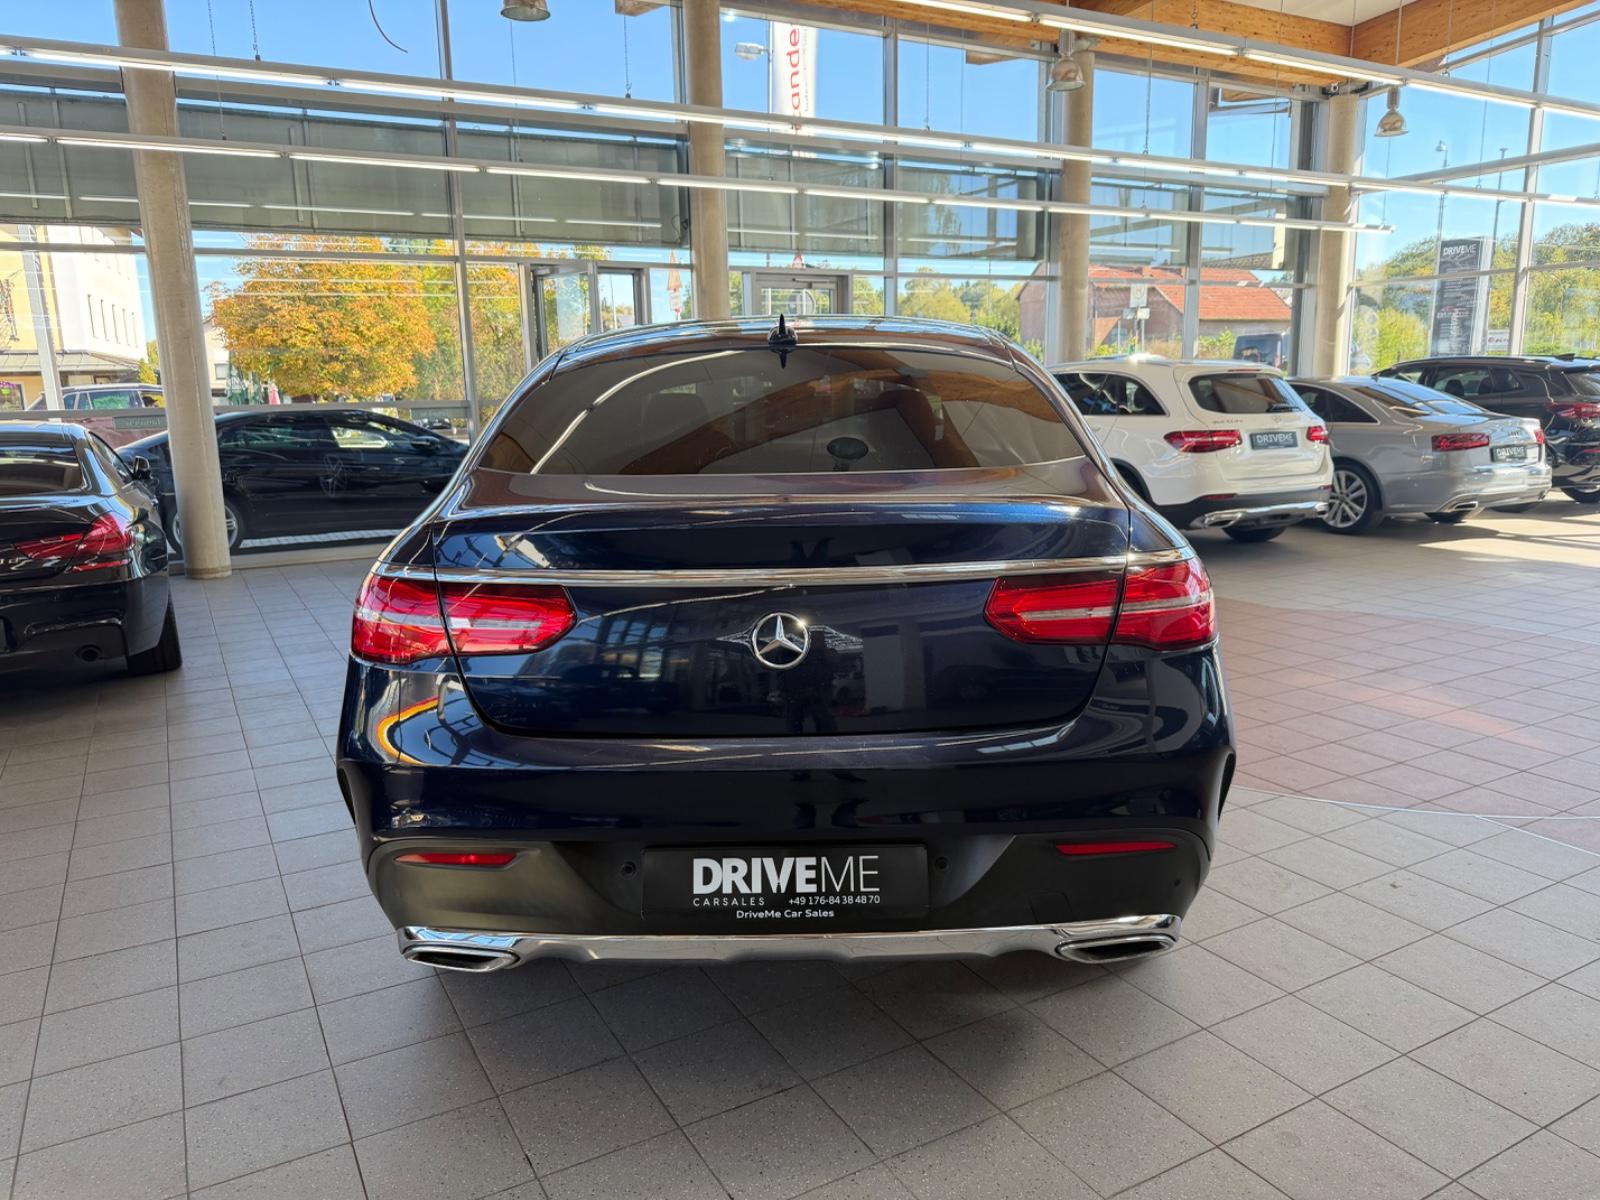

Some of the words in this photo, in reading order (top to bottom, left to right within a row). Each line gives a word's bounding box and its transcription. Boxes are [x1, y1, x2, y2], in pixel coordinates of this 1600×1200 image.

[692, 855, 881, 895] DRIVEME
[692, 897, 766, 907] CARSALES
[788, 896, 807, 906] +49
[736, 909, 782, 919] DriveMe
[784, 909, 803, 919] Car
[804, 908, 836, 918] Sales
